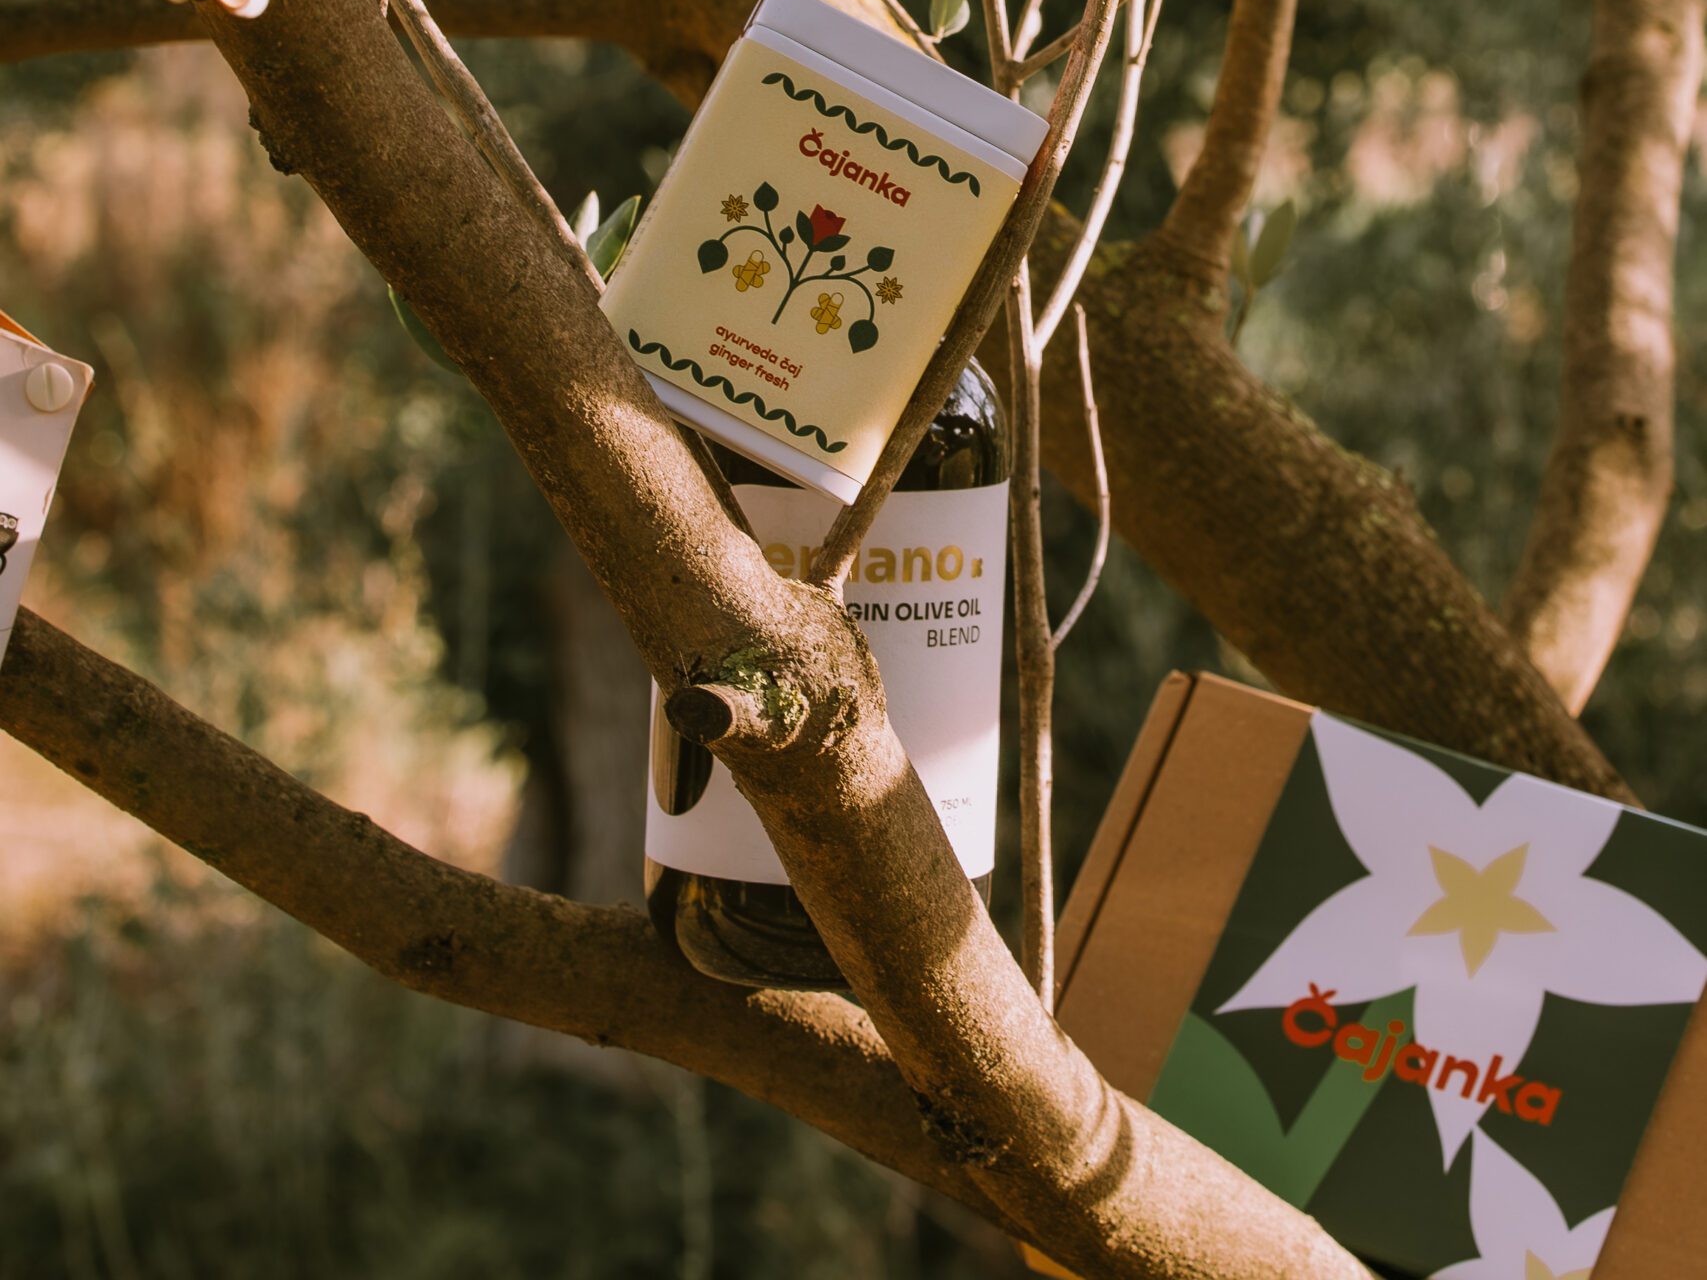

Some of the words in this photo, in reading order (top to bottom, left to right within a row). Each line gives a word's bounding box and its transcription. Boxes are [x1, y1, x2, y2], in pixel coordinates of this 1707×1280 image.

[799, 127, 911, 208] Čajanka
[709, 344, 754, 371] ginger
[755, 365, 790, 391] fresh
[715, 326, 778, 365] ayurveda
[779, 357, 803, 379] čaj
[895, 601, 954, 621] OLIVE
[958, 598, 981, 617] OIL
[927, 625, 981, 648] BLEND
[940, 799, 960, 811] 750
[1282, 981, 1562, 1126] Čajanka
